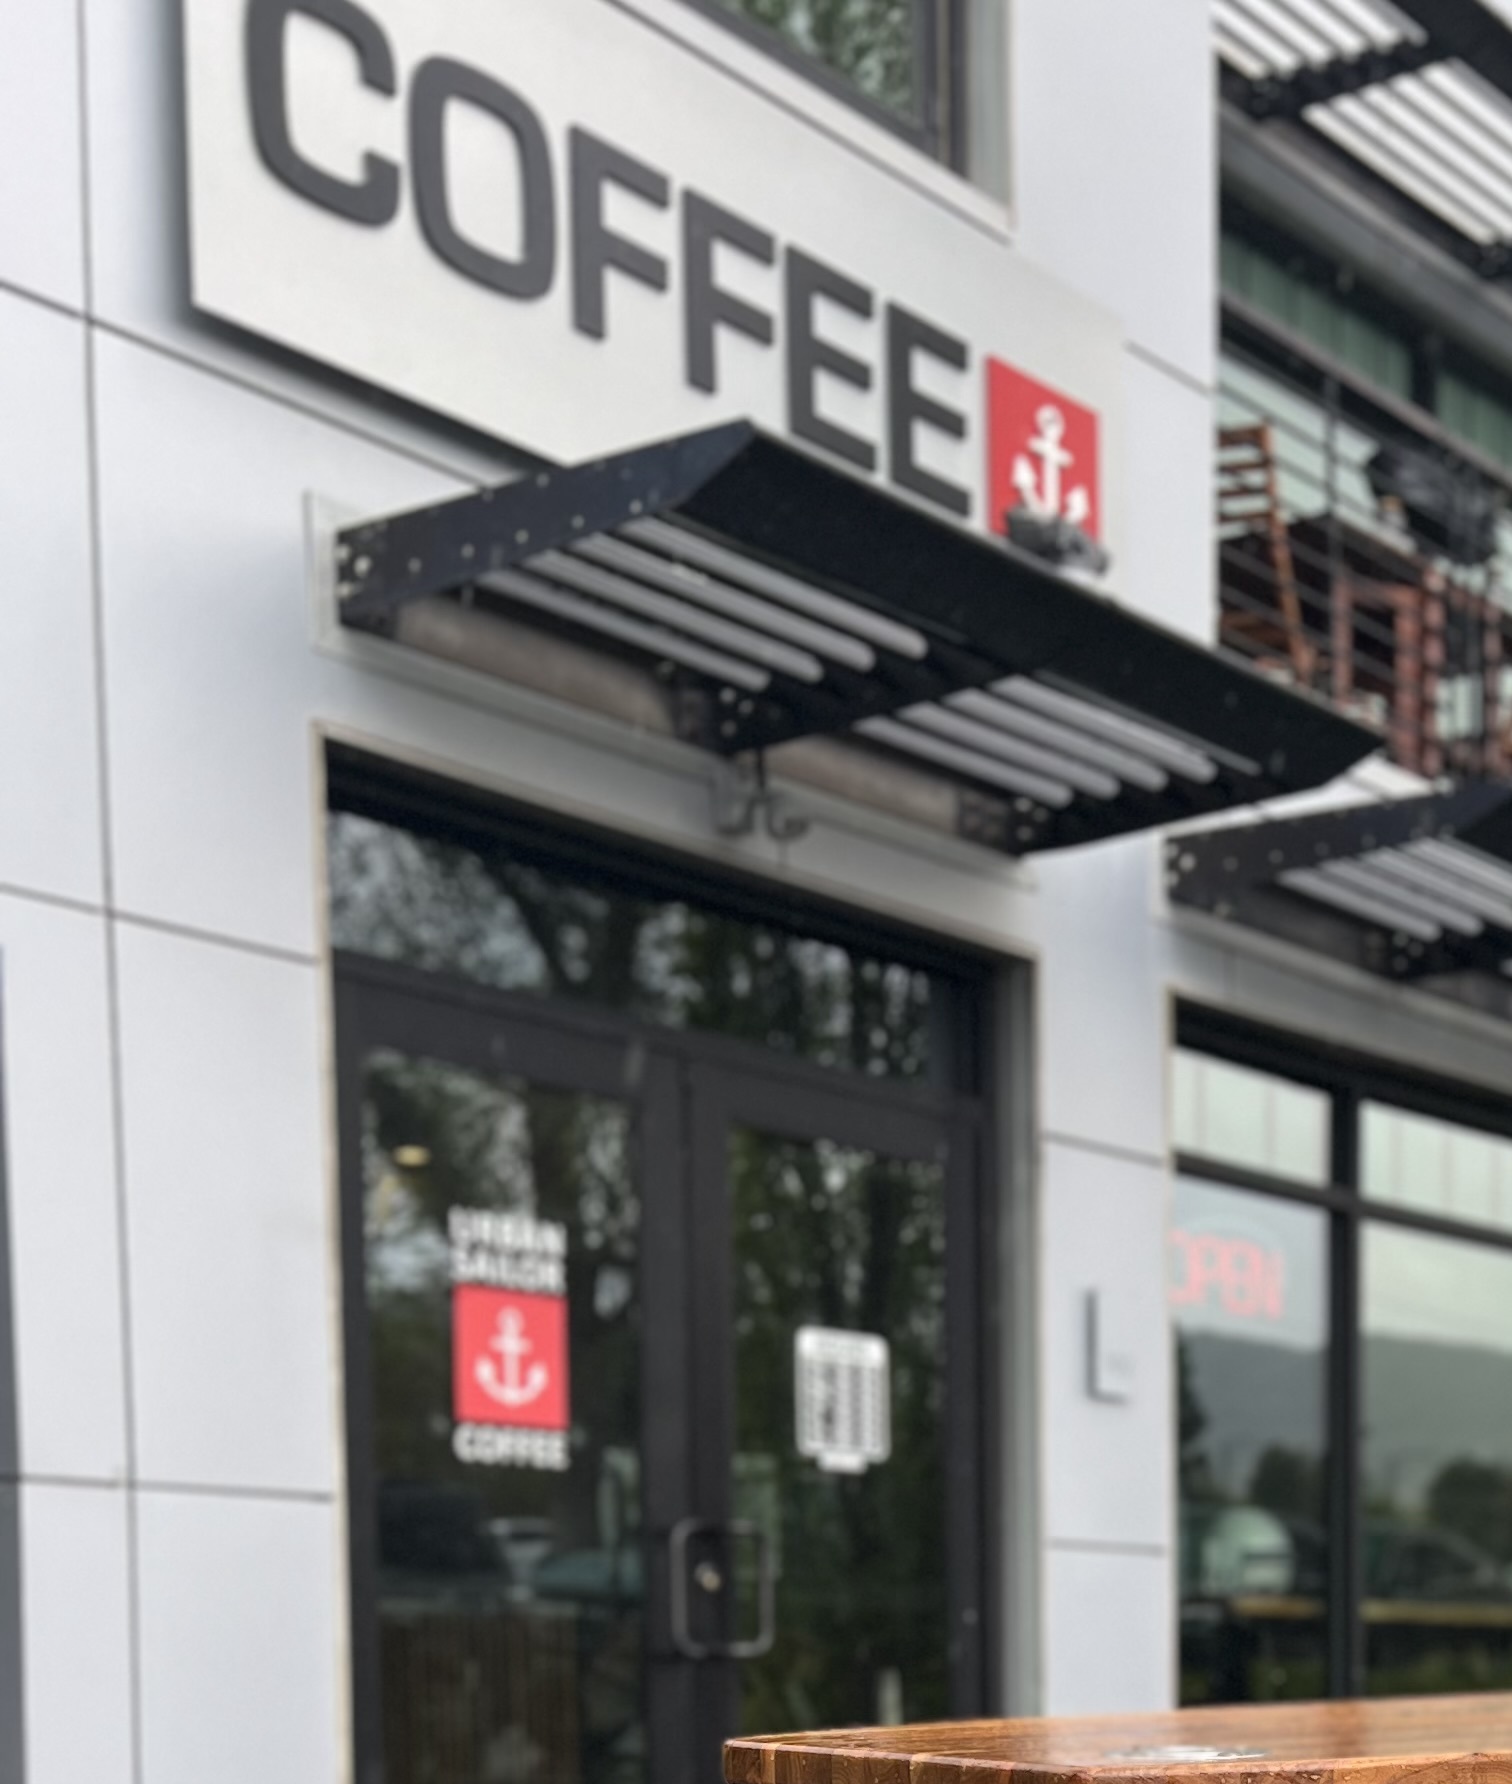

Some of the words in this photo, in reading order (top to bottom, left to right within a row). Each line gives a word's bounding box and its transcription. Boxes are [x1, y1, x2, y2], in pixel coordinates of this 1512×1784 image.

[242, 0, 972, 520] COFFEE
[448, 1205, 567, 1254] URBAN
[449, 1245, 567, 1293] SAILOR
[452, 1420, 571, 1471] COFFEE
